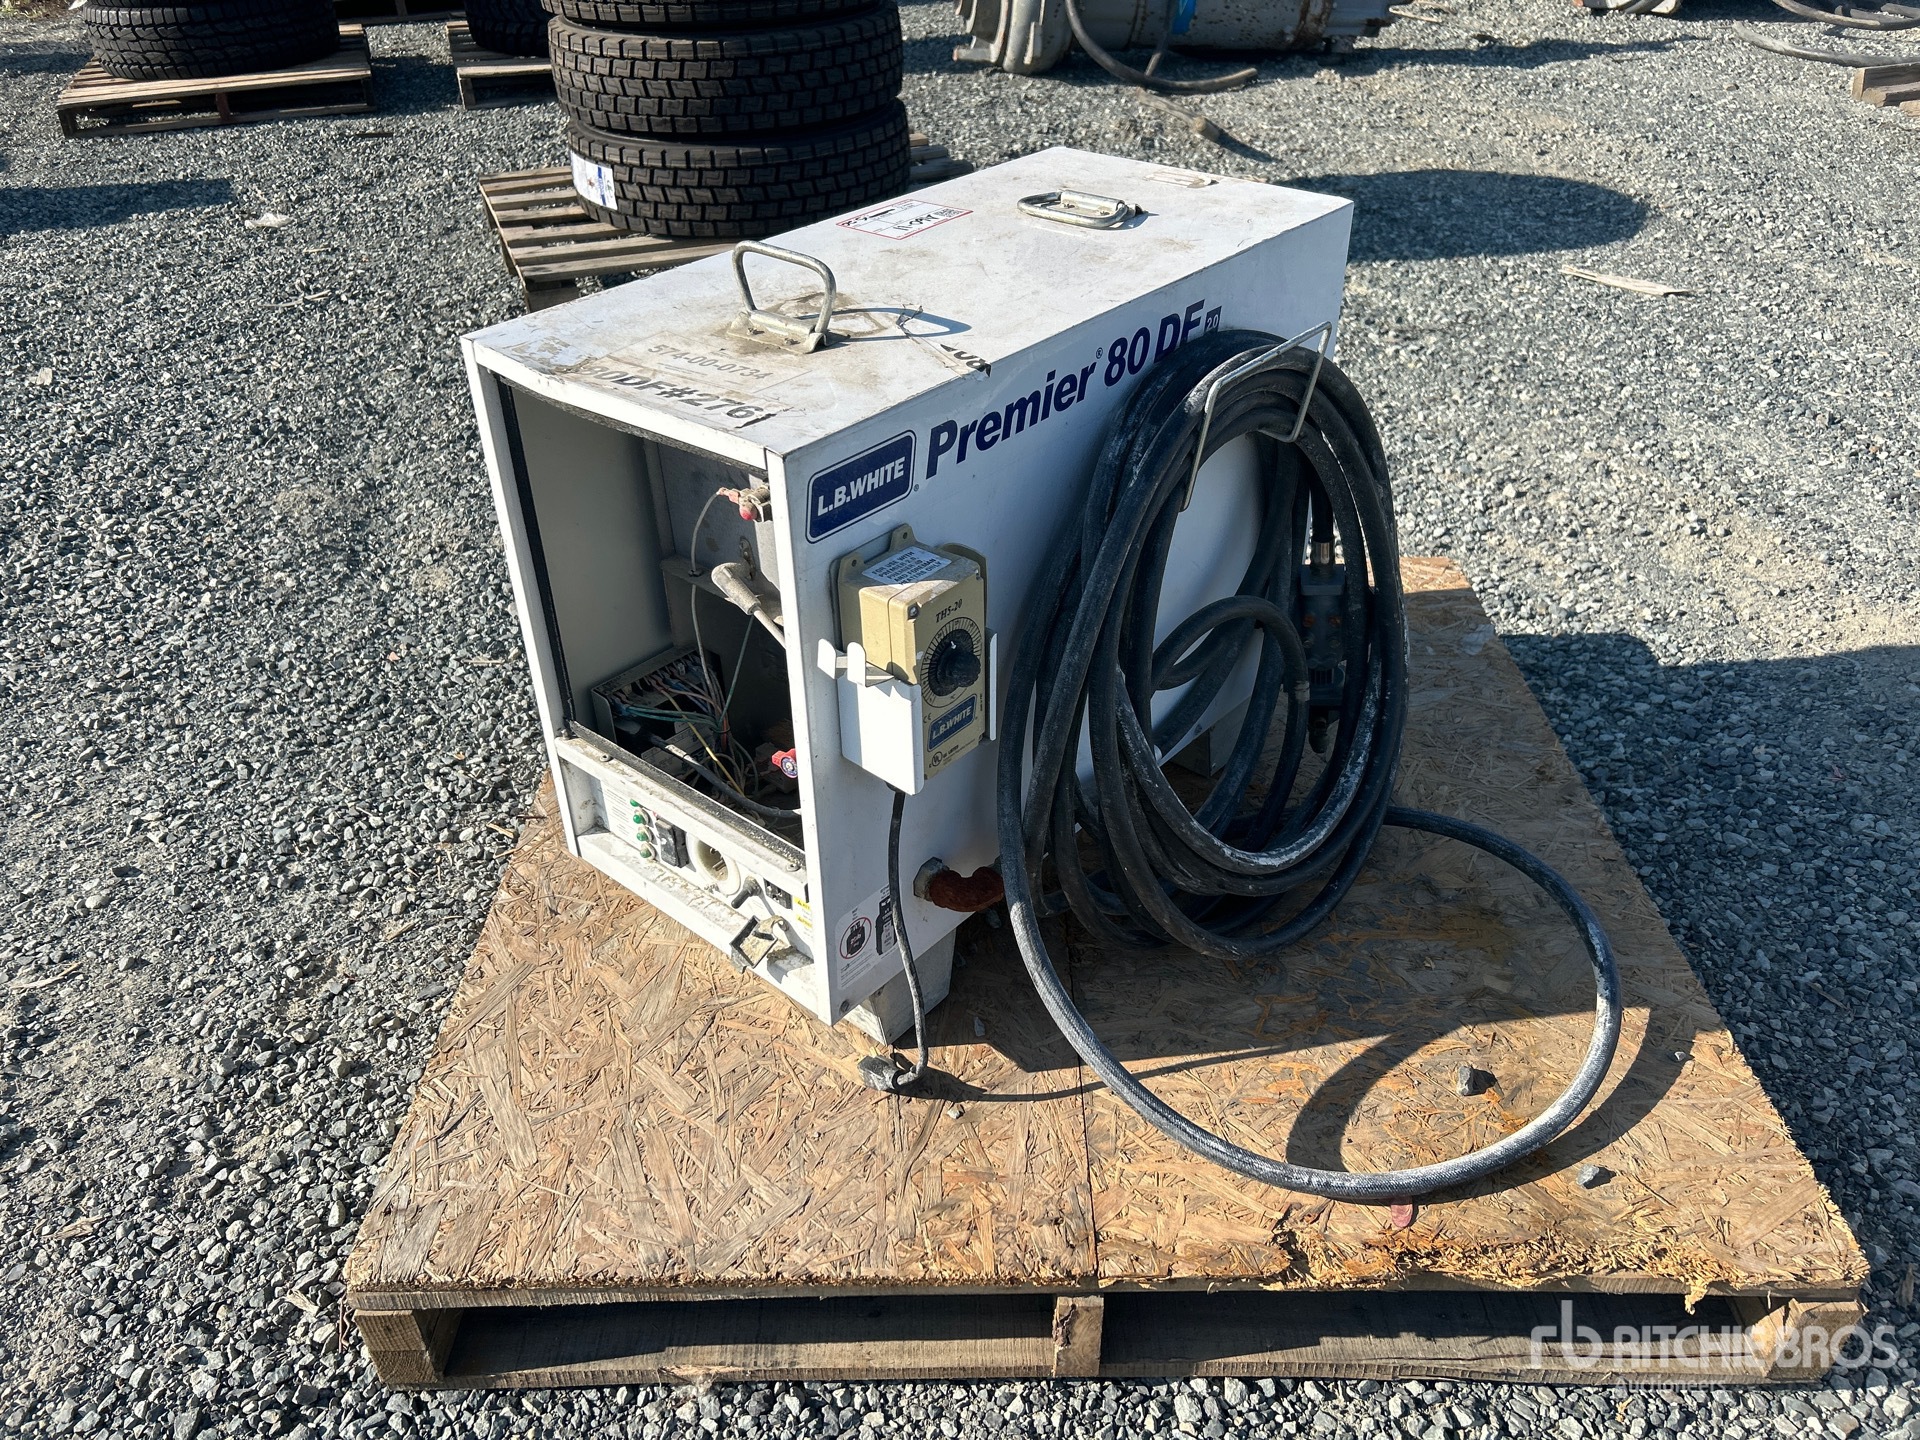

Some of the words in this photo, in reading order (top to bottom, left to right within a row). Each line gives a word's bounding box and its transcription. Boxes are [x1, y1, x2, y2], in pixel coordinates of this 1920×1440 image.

[648, 344, 774, 380] 574-00-0734
[925, 361, 1097, 480] Premier
[1104, 326, 1151, 387] 80
[1153, 298, 1205, 364] DF
[817, 456, 906, 517] L.B.WHITE
[871, 566, 886, 575] FOR
[885, 560, 898, 569] USE
[897, 551, 915, 561] WITH
[879, 562, 907, 577] PREMIER
[894, 573, 908, 582] AND
[906, 558, 937, 575] FOREMAN
[925, 561, 942, 572] ONLY
[935, 598, 963, 623] THS-20
